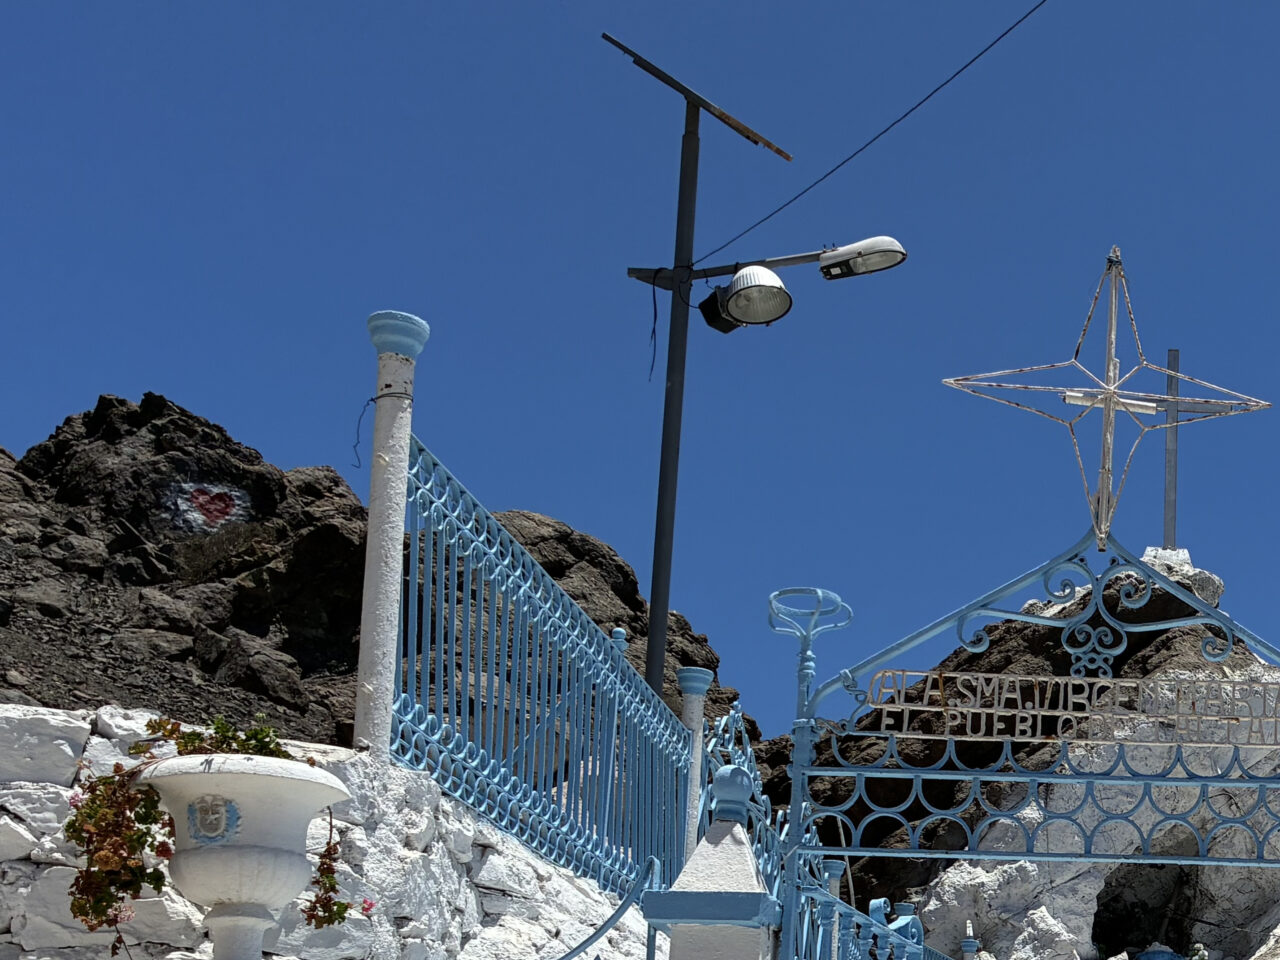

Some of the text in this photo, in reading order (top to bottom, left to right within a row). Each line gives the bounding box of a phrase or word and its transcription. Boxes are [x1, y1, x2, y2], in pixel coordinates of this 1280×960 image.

[1034, 677, 1159, 714] VIRGEN
[880, 707, 923, 735] EL
[944, 709, 1078, 741] PUEBLO
